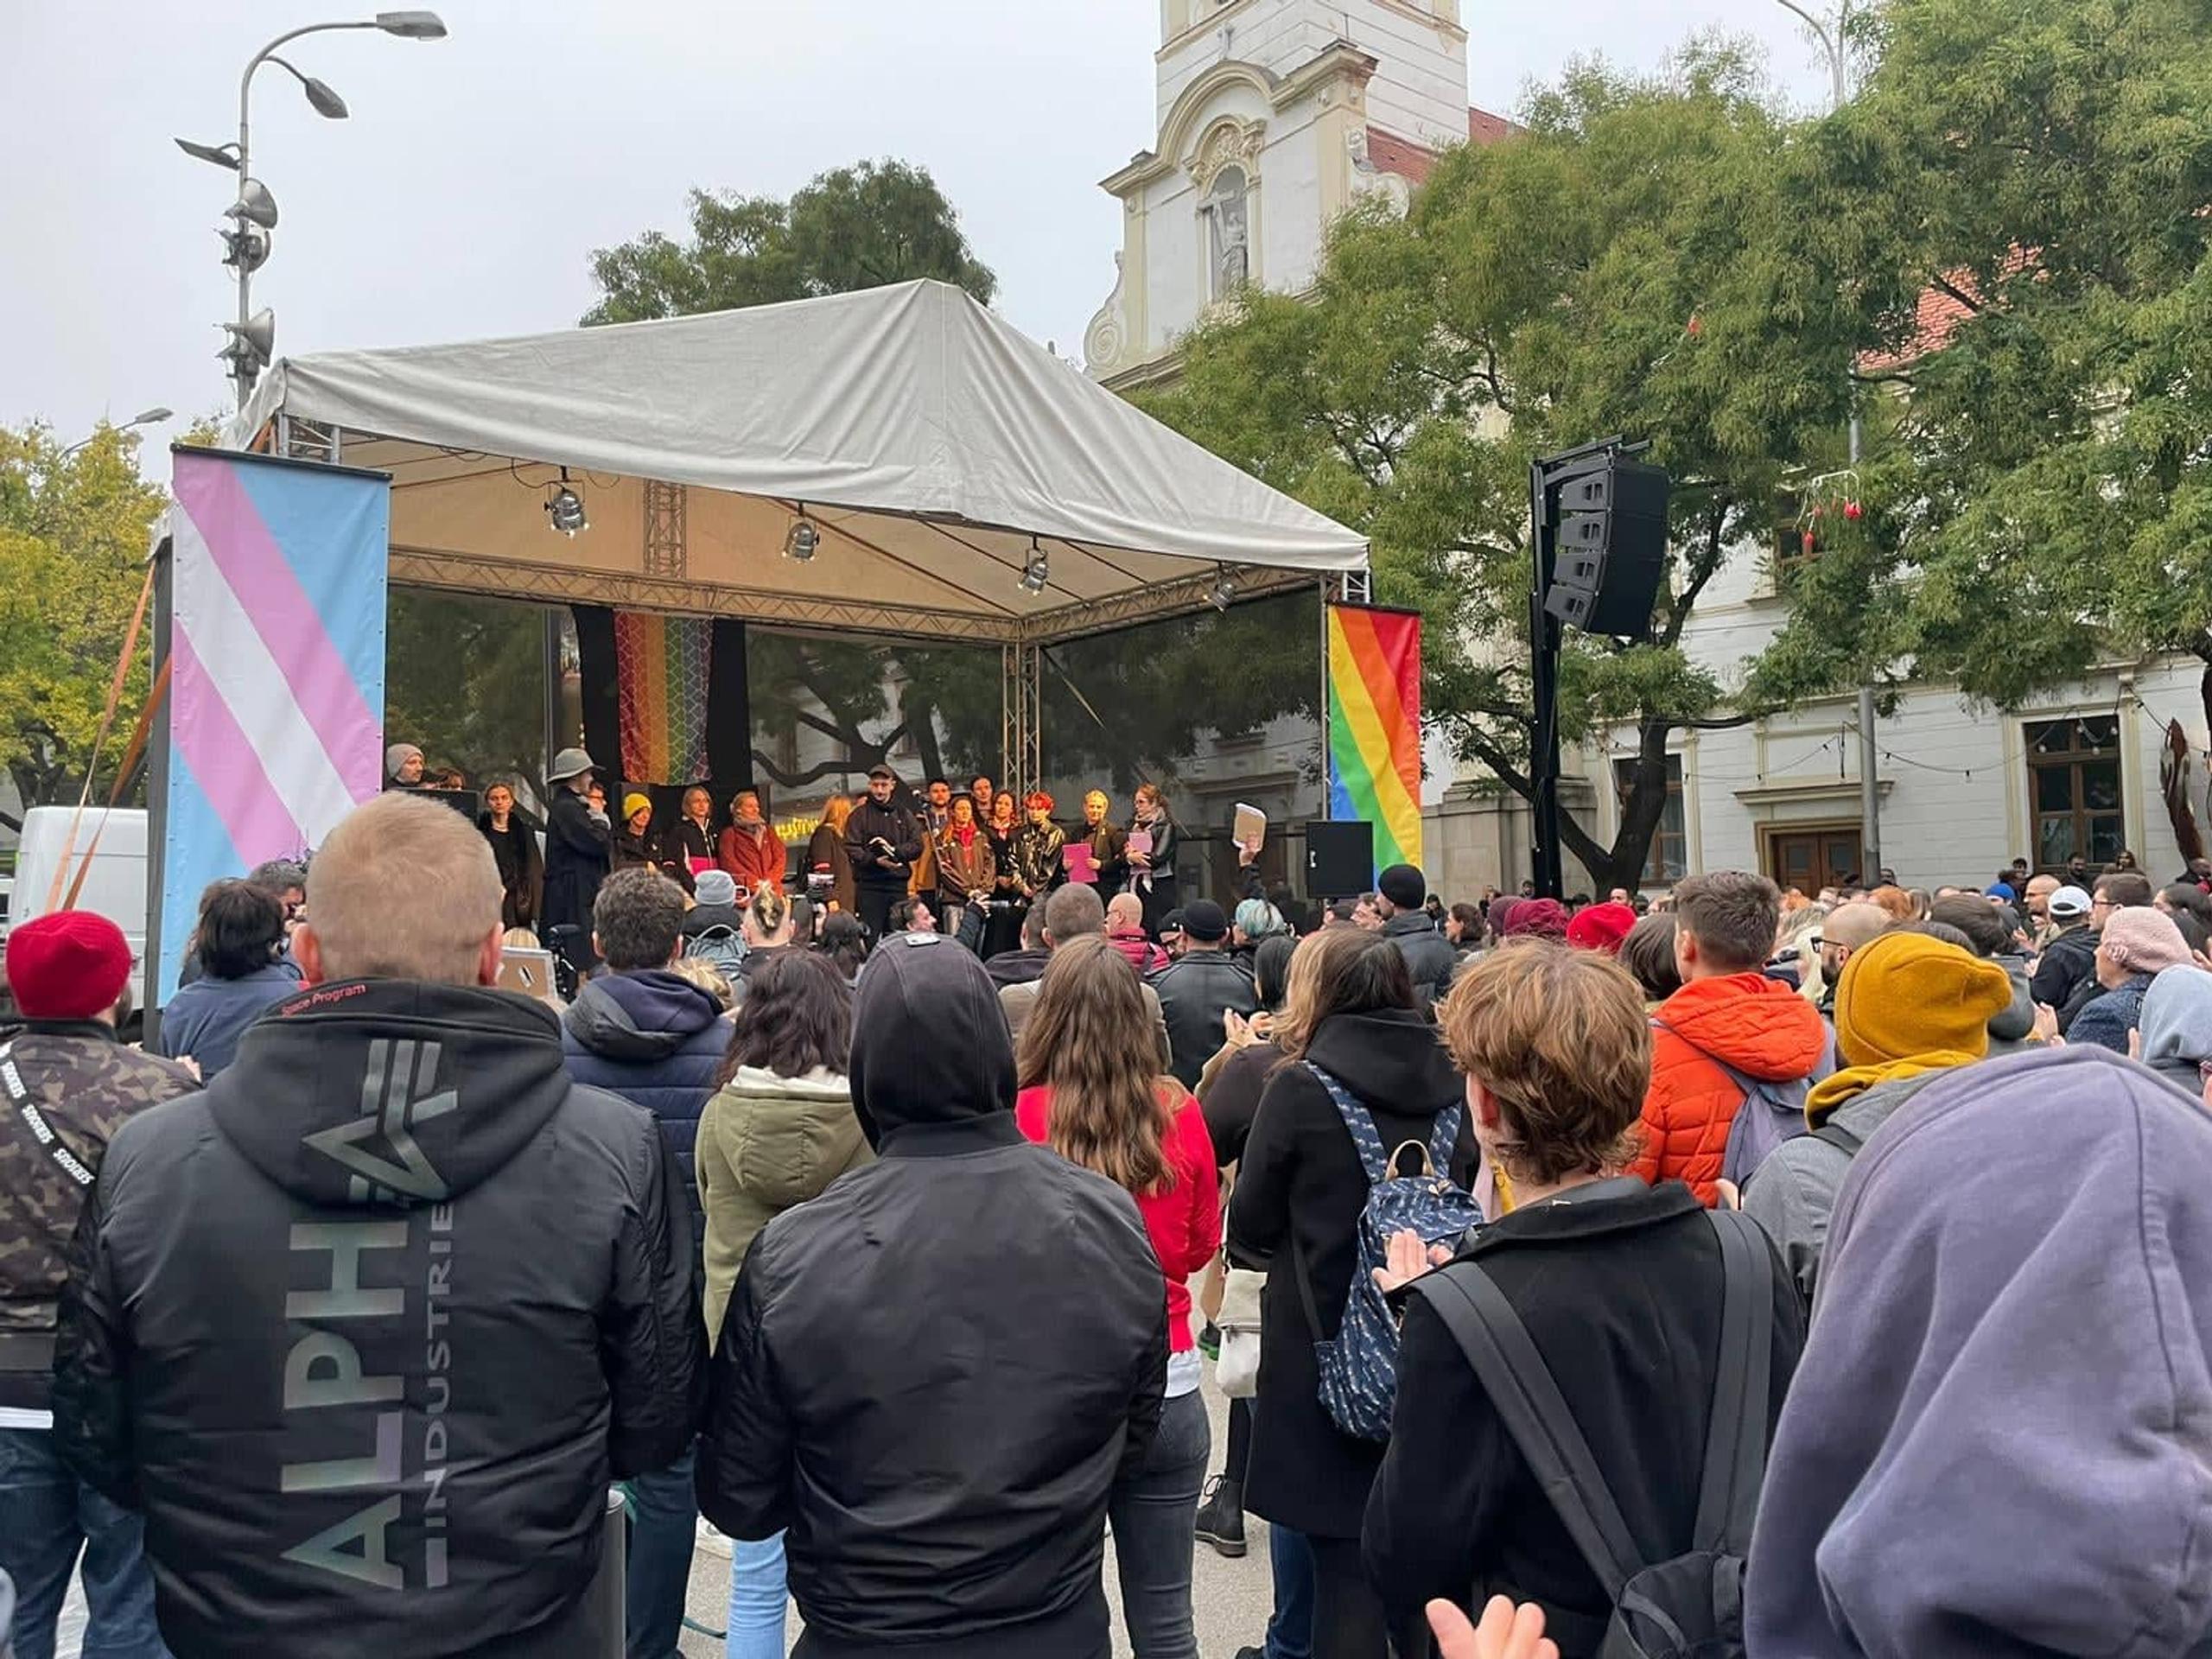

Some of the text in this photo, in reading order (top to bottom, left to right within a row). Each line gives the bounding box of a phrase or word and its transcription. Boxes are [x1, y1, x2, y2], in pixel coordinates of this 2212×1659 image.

[312, 984, 366, 1004] Program
[22, 1103, 54, 1144] SERIOUS
[53, 1147, 95, 1185] SERIOUS
[424, 1202, 454, 1528] INDUSTRIE
[280, 1221, 409, 1591] ALPH
